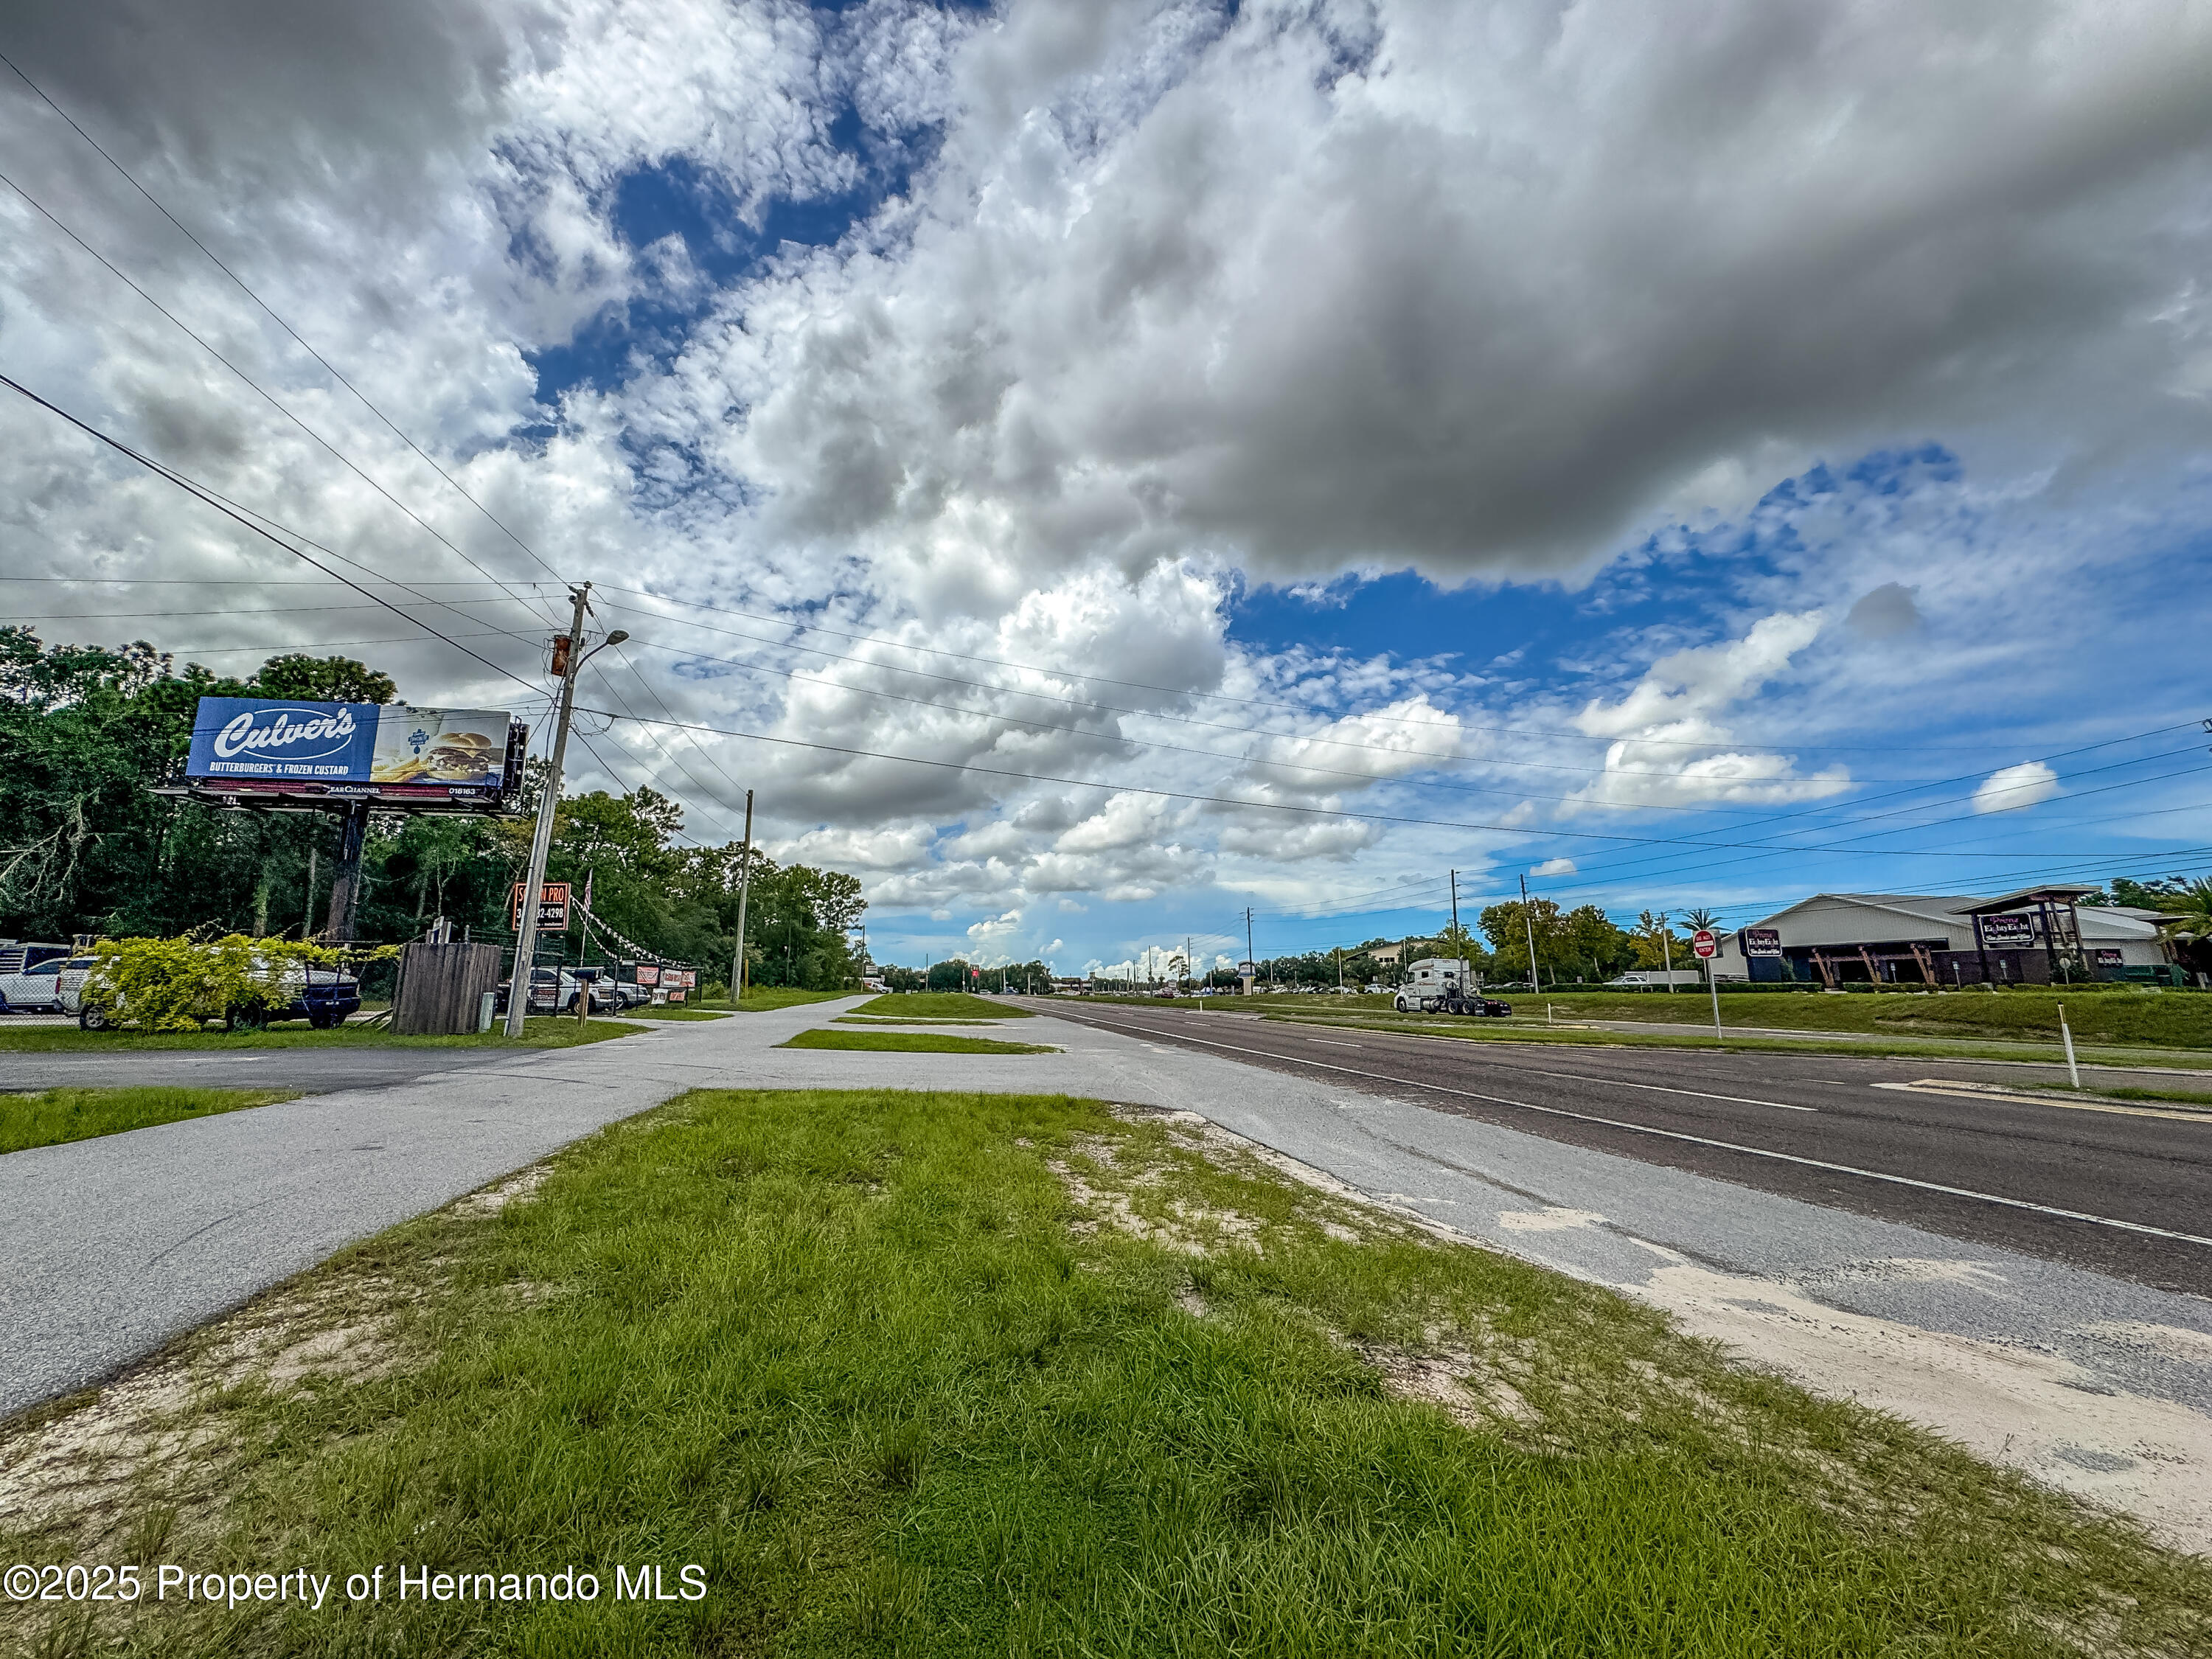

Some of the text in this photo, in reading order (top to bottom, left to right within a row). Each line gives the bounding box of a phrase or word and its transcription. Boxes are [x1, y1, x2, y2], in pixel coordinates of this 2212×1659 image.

[215, 708, 356, 758] Culver's
[276, 765, 282, 773] &
[285, 764, 311, 774] FROZEN
[314, 765, 349, 775] CUSTARD
[549, 887, 564, 901] PRO
